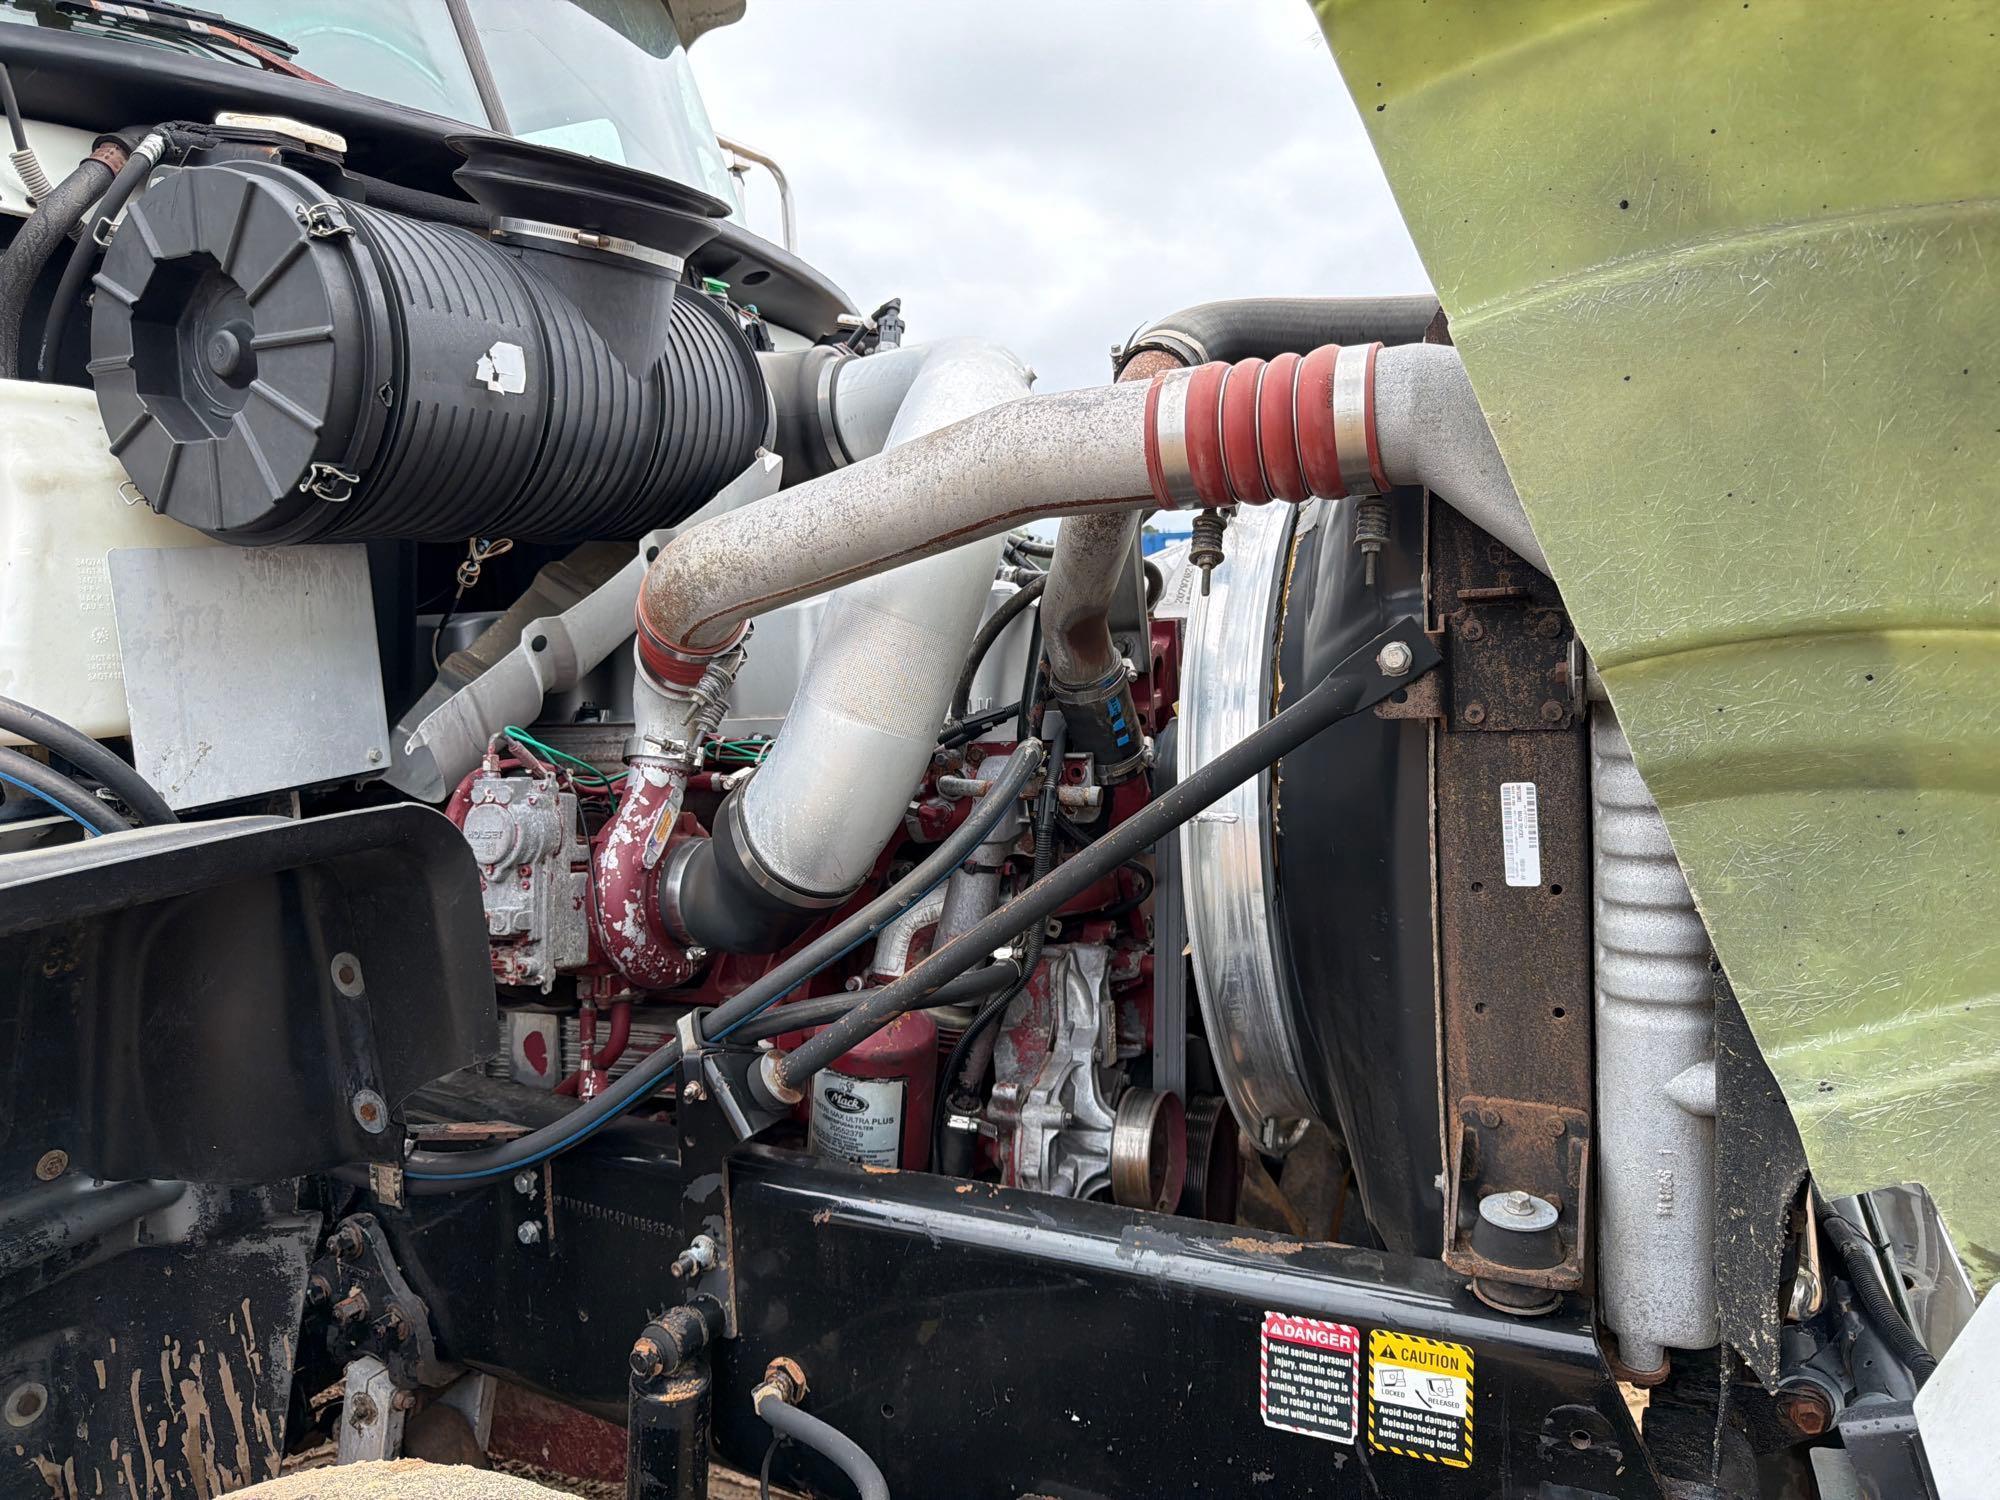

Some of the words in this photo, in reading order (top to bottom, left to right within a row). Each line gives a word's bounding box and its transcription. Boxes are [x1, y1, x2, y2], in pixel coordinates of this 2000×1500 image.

[831, 1092, 860, 1109] Mack
[846, 1116, 869, 1125] ULTRA
[872, 1117, 894, 1125] PLUS
[1284, 1326, 1350, 1348] DANGER
[1269, 1343, 1289, 1355] Avoid
[1290, 1348, 1318, 1361] serious
[1319, 1354, 1351, 1368] personal
[1401, 1348, 1459, 1370] CAUTION
[1274, 1356, 1297, 1370] injury,
[1299, 1363, 1325, 1374] remain
[1327, 1368, 1346, 1379] clear
[1271, 1369, 1279, 1378] of
[1280, 1370, 1292, 1380] fan
[1294, 1373, 1312, 1385] when
[1314, 1378, 1339, 1390] engine
[1342, 1383, 1349, 1392] is
[1269, 1381, 1298, 1395] running.
[1301, 1386, 1315, 1397] Fan
[1316, 1392, 1332, 1402] may
[1334, 1394, 1351, 1405] start
[1382, 1388, 1405, 1398] LOCKED
[1428, 1397, 1460, 1409] RELEASED
[1280, 1395, 1288, 1404] to
[1290, 1398, 1310, 1409] rotate
[1312, 1402, 1319, 1411] at
[1322, 1403, 1338, 1415] high
[1268, 1405, 1289, 1416] speed
[1291, 1410, 1317, 1423] without
[1319, 1417, 1350, 1431] warning.
[1379, 1405, 1401, 1417] Avoid
[1403, 1410, 1422, 1422] hood
[1425, 1414, 1460, 1429] damage.
[1382, 1418, 1414, 1431] Release
[1417, 1424, 1436, 1435] hood
[1439, 1430, 1456, 1440] prop
[1379, 1429, 1404, 1440] before
[1406, 1435, 1434, 1448] closing
[1437, 1440, 1459, 1452] hood.
